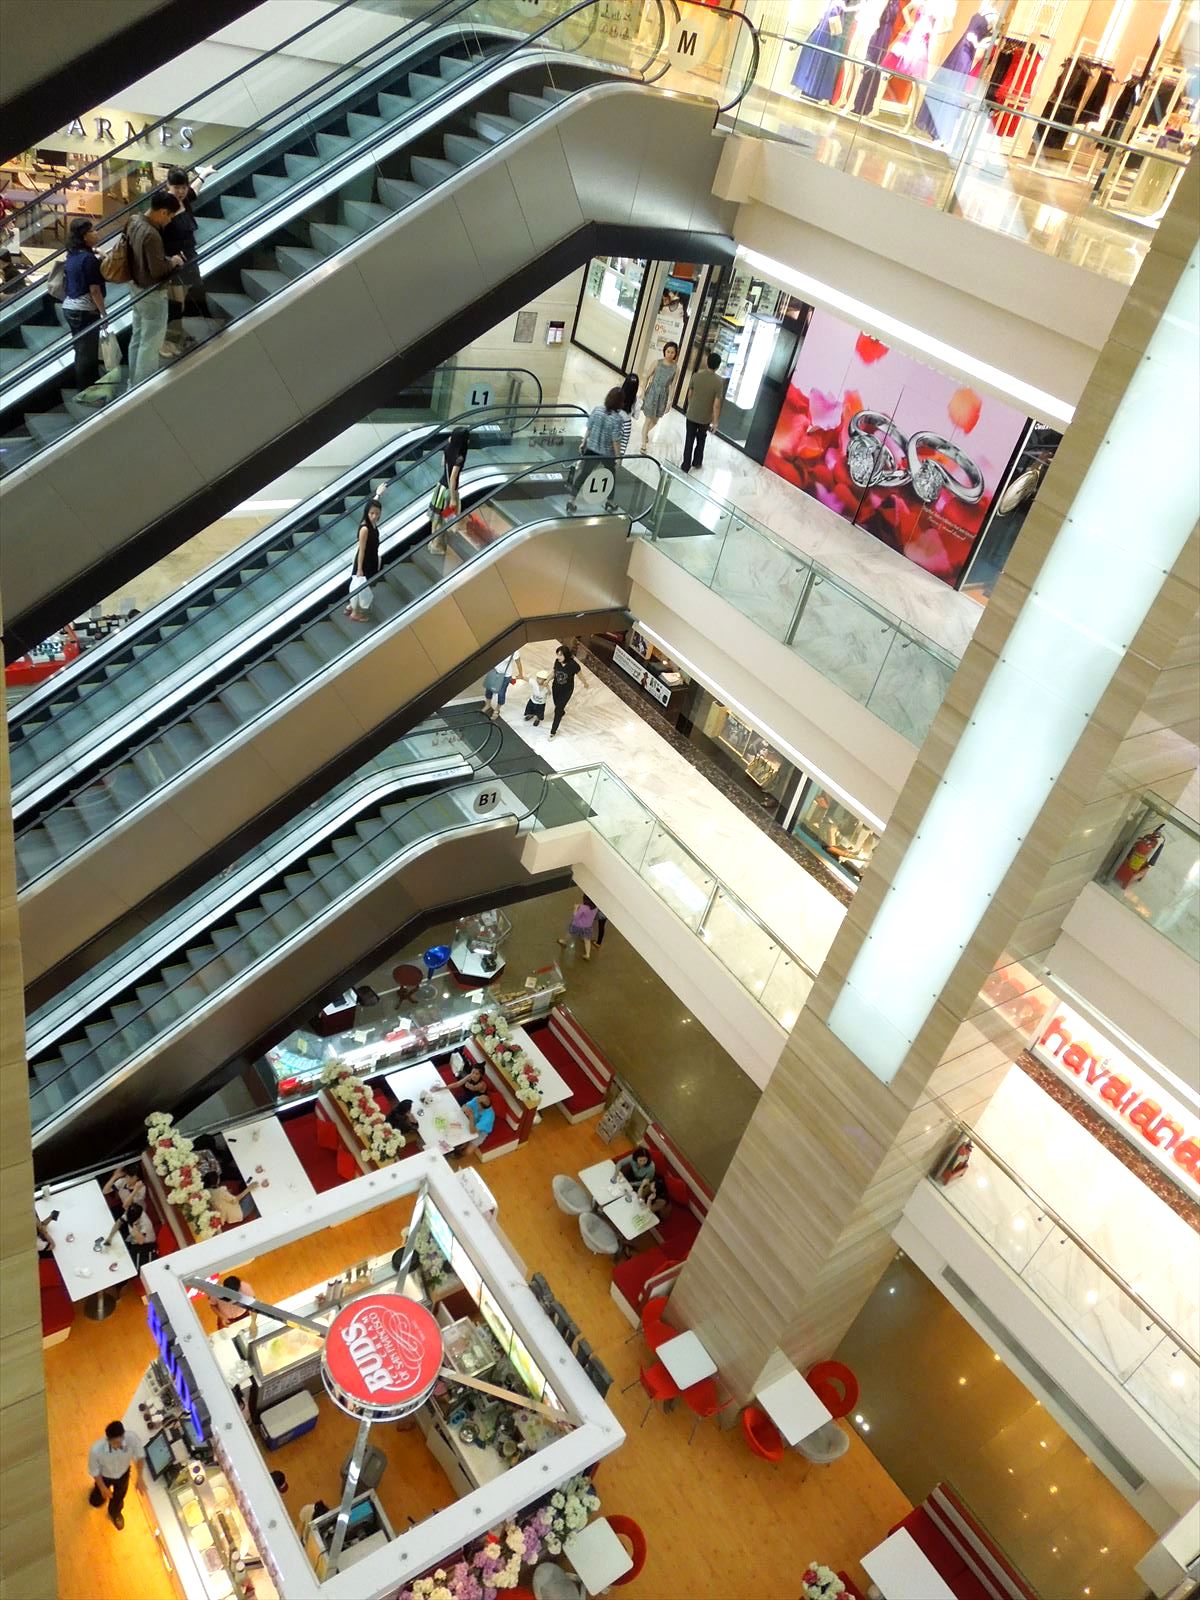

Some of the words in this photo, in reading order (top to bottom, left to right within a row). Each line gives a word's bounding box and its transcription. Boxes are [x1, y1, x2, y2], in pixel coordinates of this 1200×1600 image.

[676, 29, 698, 56] M
[57, 116, 194, 149] ARMES
[471, 389, 489, 405] L1
[589, 477, 609, 494] L1
[478, 791, 498, 806] B1
